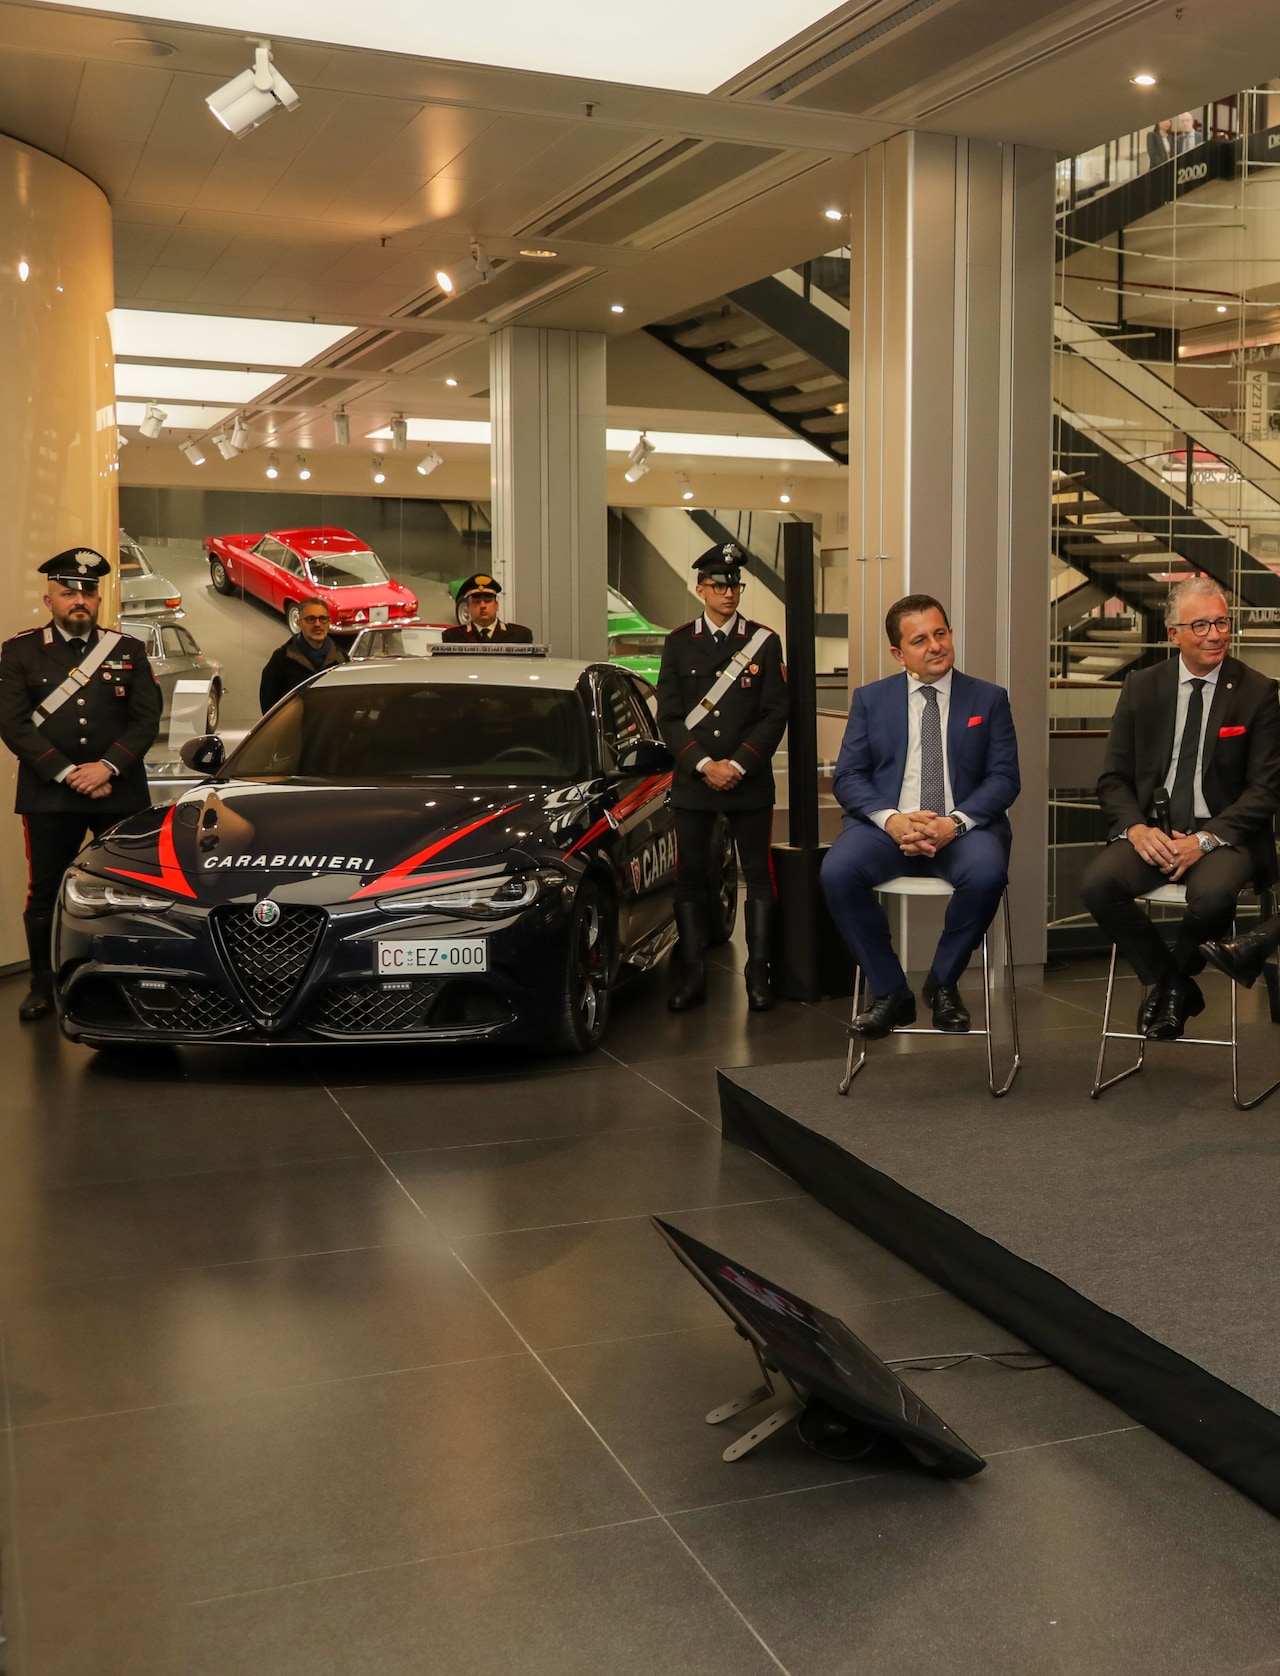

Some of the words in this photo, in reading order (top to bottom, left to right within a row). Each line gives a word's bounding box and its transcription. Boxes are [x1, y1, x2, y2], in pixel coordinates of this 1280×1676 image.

[1177, 162, 1207, 185] 2000
[203, 854, 376, 871] CARABINIERI
[643, 829, 677, 888] CARA
